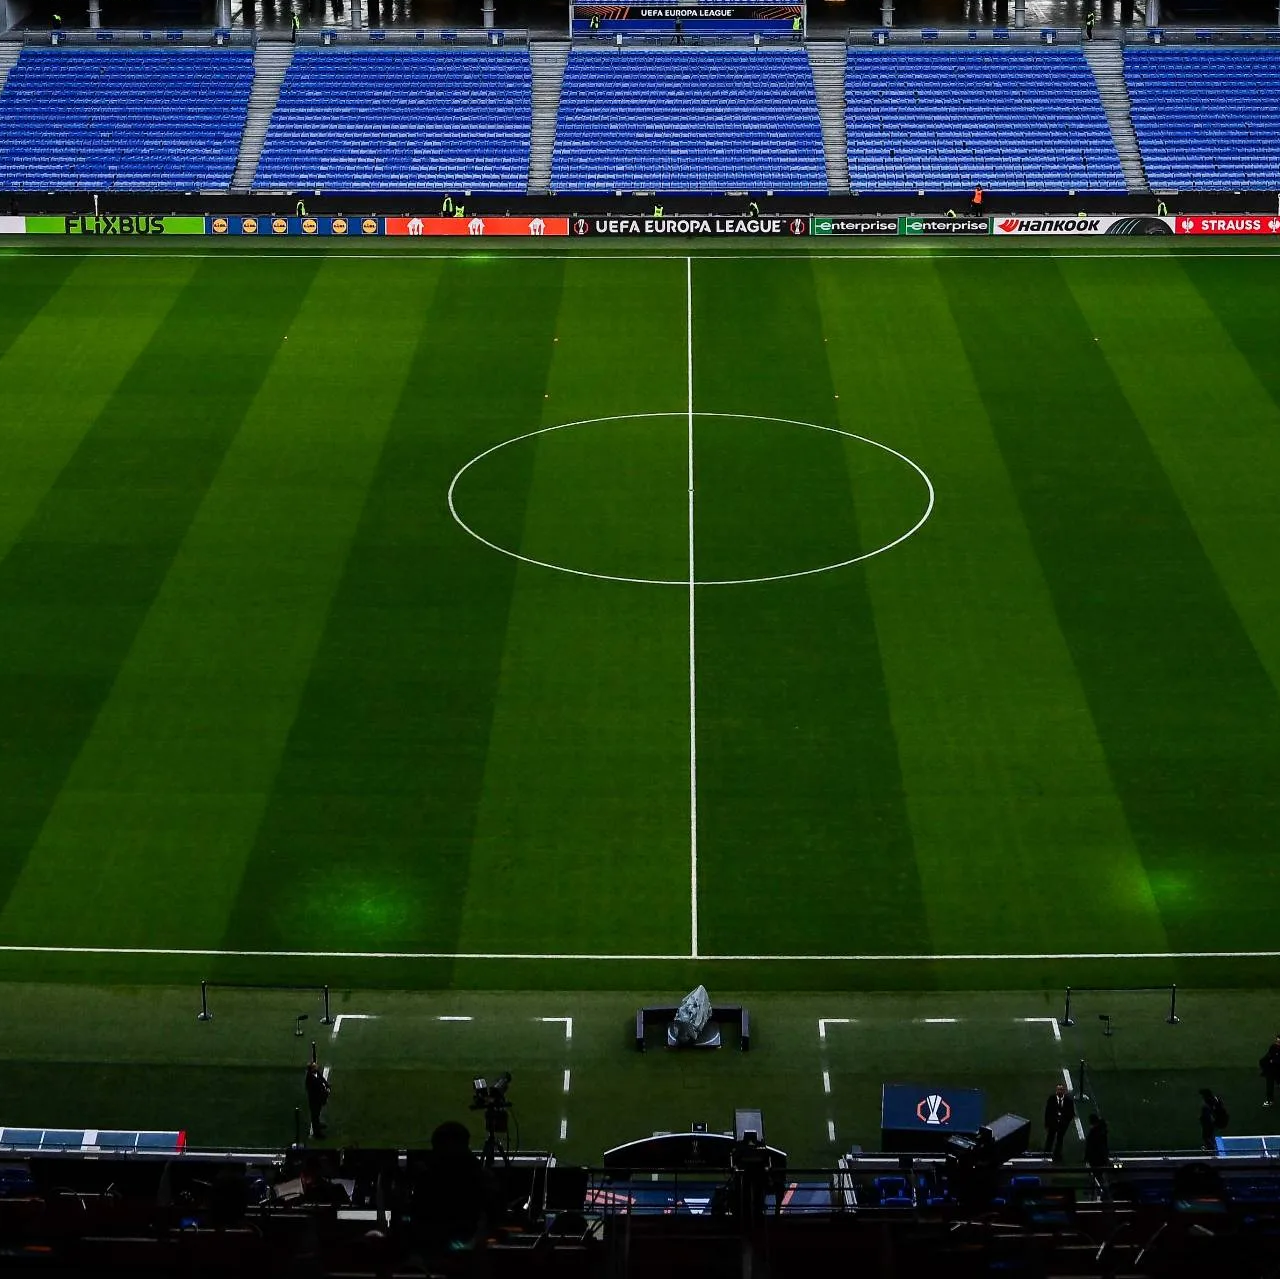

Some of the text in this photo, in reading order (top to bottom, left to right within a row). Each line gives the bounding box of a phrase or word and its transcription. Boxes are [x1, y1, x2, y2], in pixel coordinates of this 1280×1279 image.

[641, 9, 730, 17] UEFA EUROPA LEAGUE
[596, 220, 781, 233] UEFA EUROPA LEAGUE
[820, 219, 897, 233] enterprise
[911, 219, 988, 233] enterprise
[1201, 219, 1261, 230] STRAUSS
